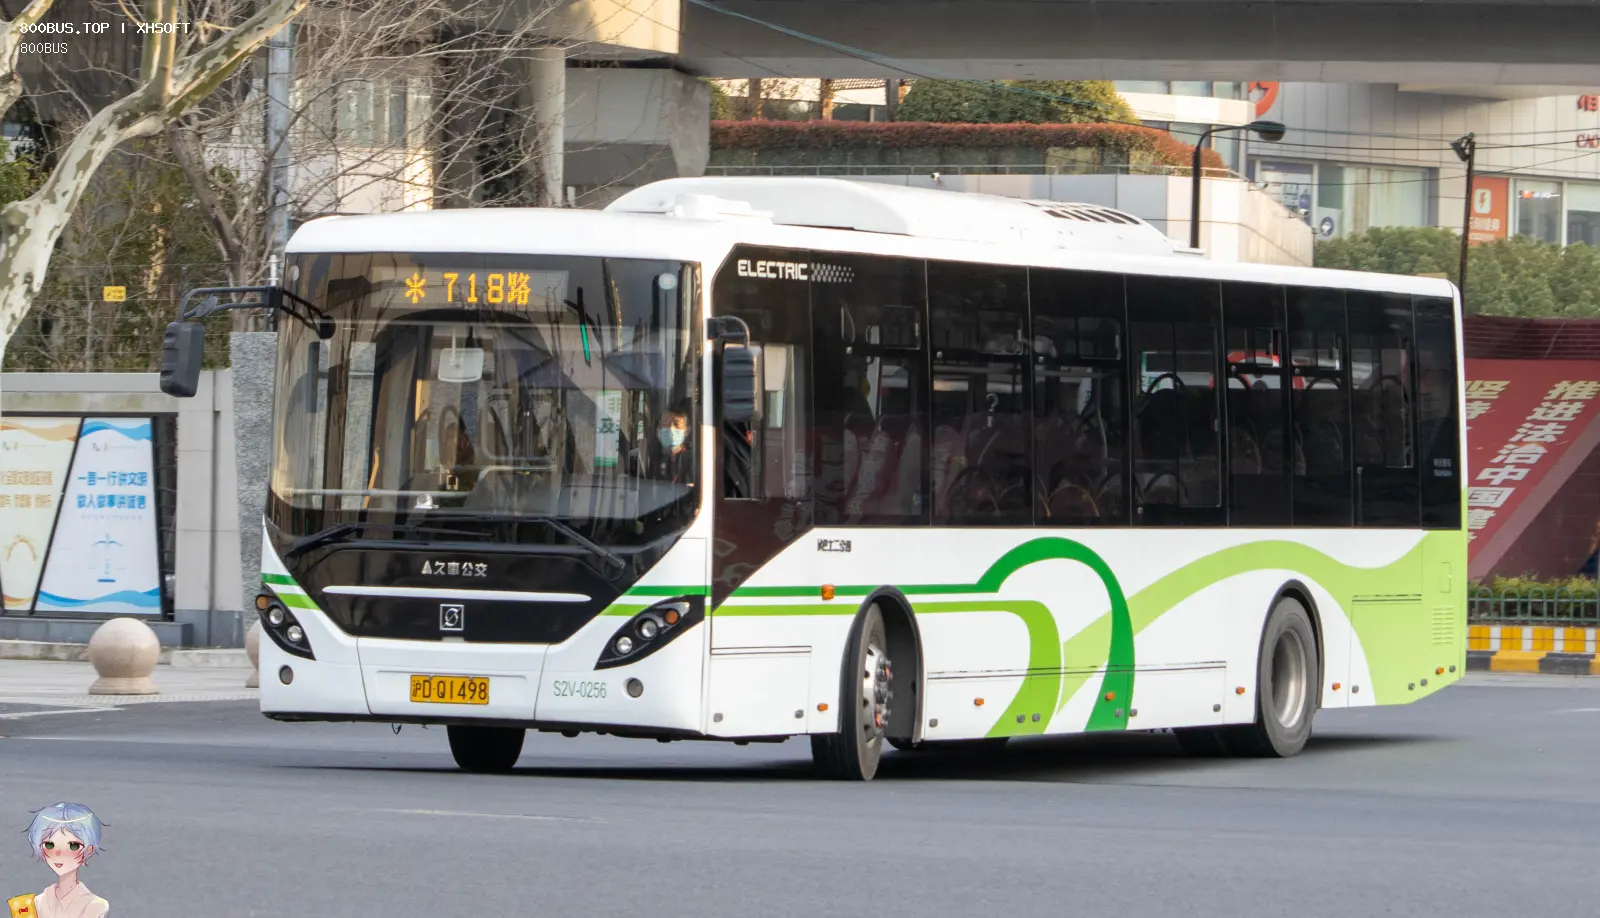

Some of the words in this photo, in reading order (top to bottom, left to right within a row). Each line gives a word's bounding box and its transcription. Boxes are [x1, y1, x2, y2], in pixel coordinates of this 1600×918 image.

[737, 259, 809, 281] ELECTRIC
[443, 271, 532, 305] 718路
[1467, 379, 1600, 544] 推进法治中国建
[553, 680, 607, 698] S2V-0256
